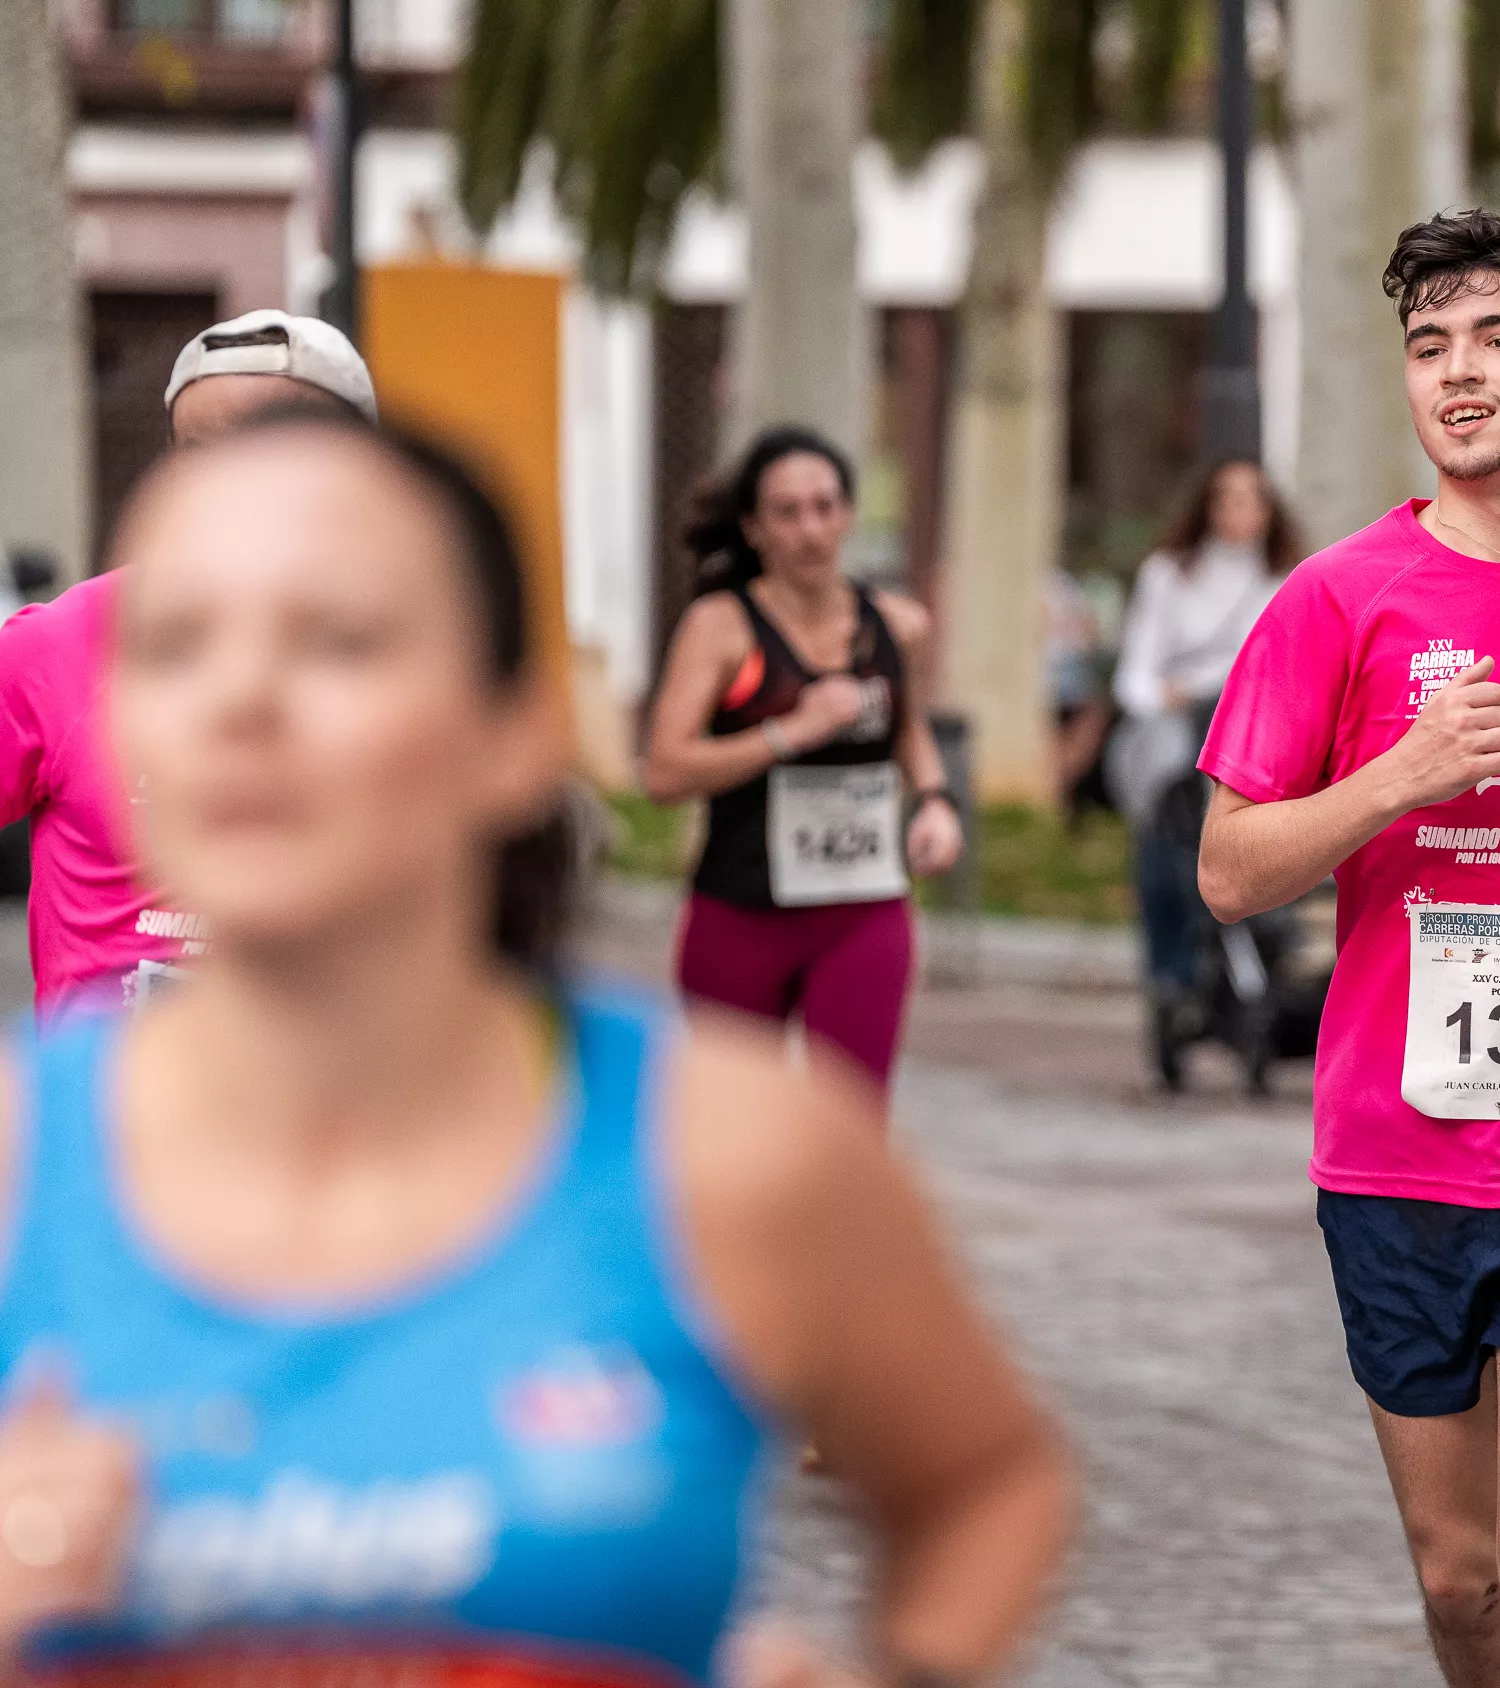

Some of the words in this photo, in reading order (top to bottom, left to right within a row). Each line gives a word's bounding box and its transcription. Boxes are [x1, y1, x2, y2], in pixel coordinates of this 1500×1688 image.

[1428, 639, 1453, 651] XXV
[1410, 649, 1475, 670] CARRERA
[1455, 852, 1475, 864] POR
[1474, 852, 1488, 864] LA
[1420, 914, 1464, 923] CIRCUITO
[1420, 923, 1475, 935] CARRERAS
[1420, 935, 1474, 945] DIPUTACIÓN
[1472, 974, 1492, 983] XXV
[1445, 1081, 1470, 1090] JUAN
